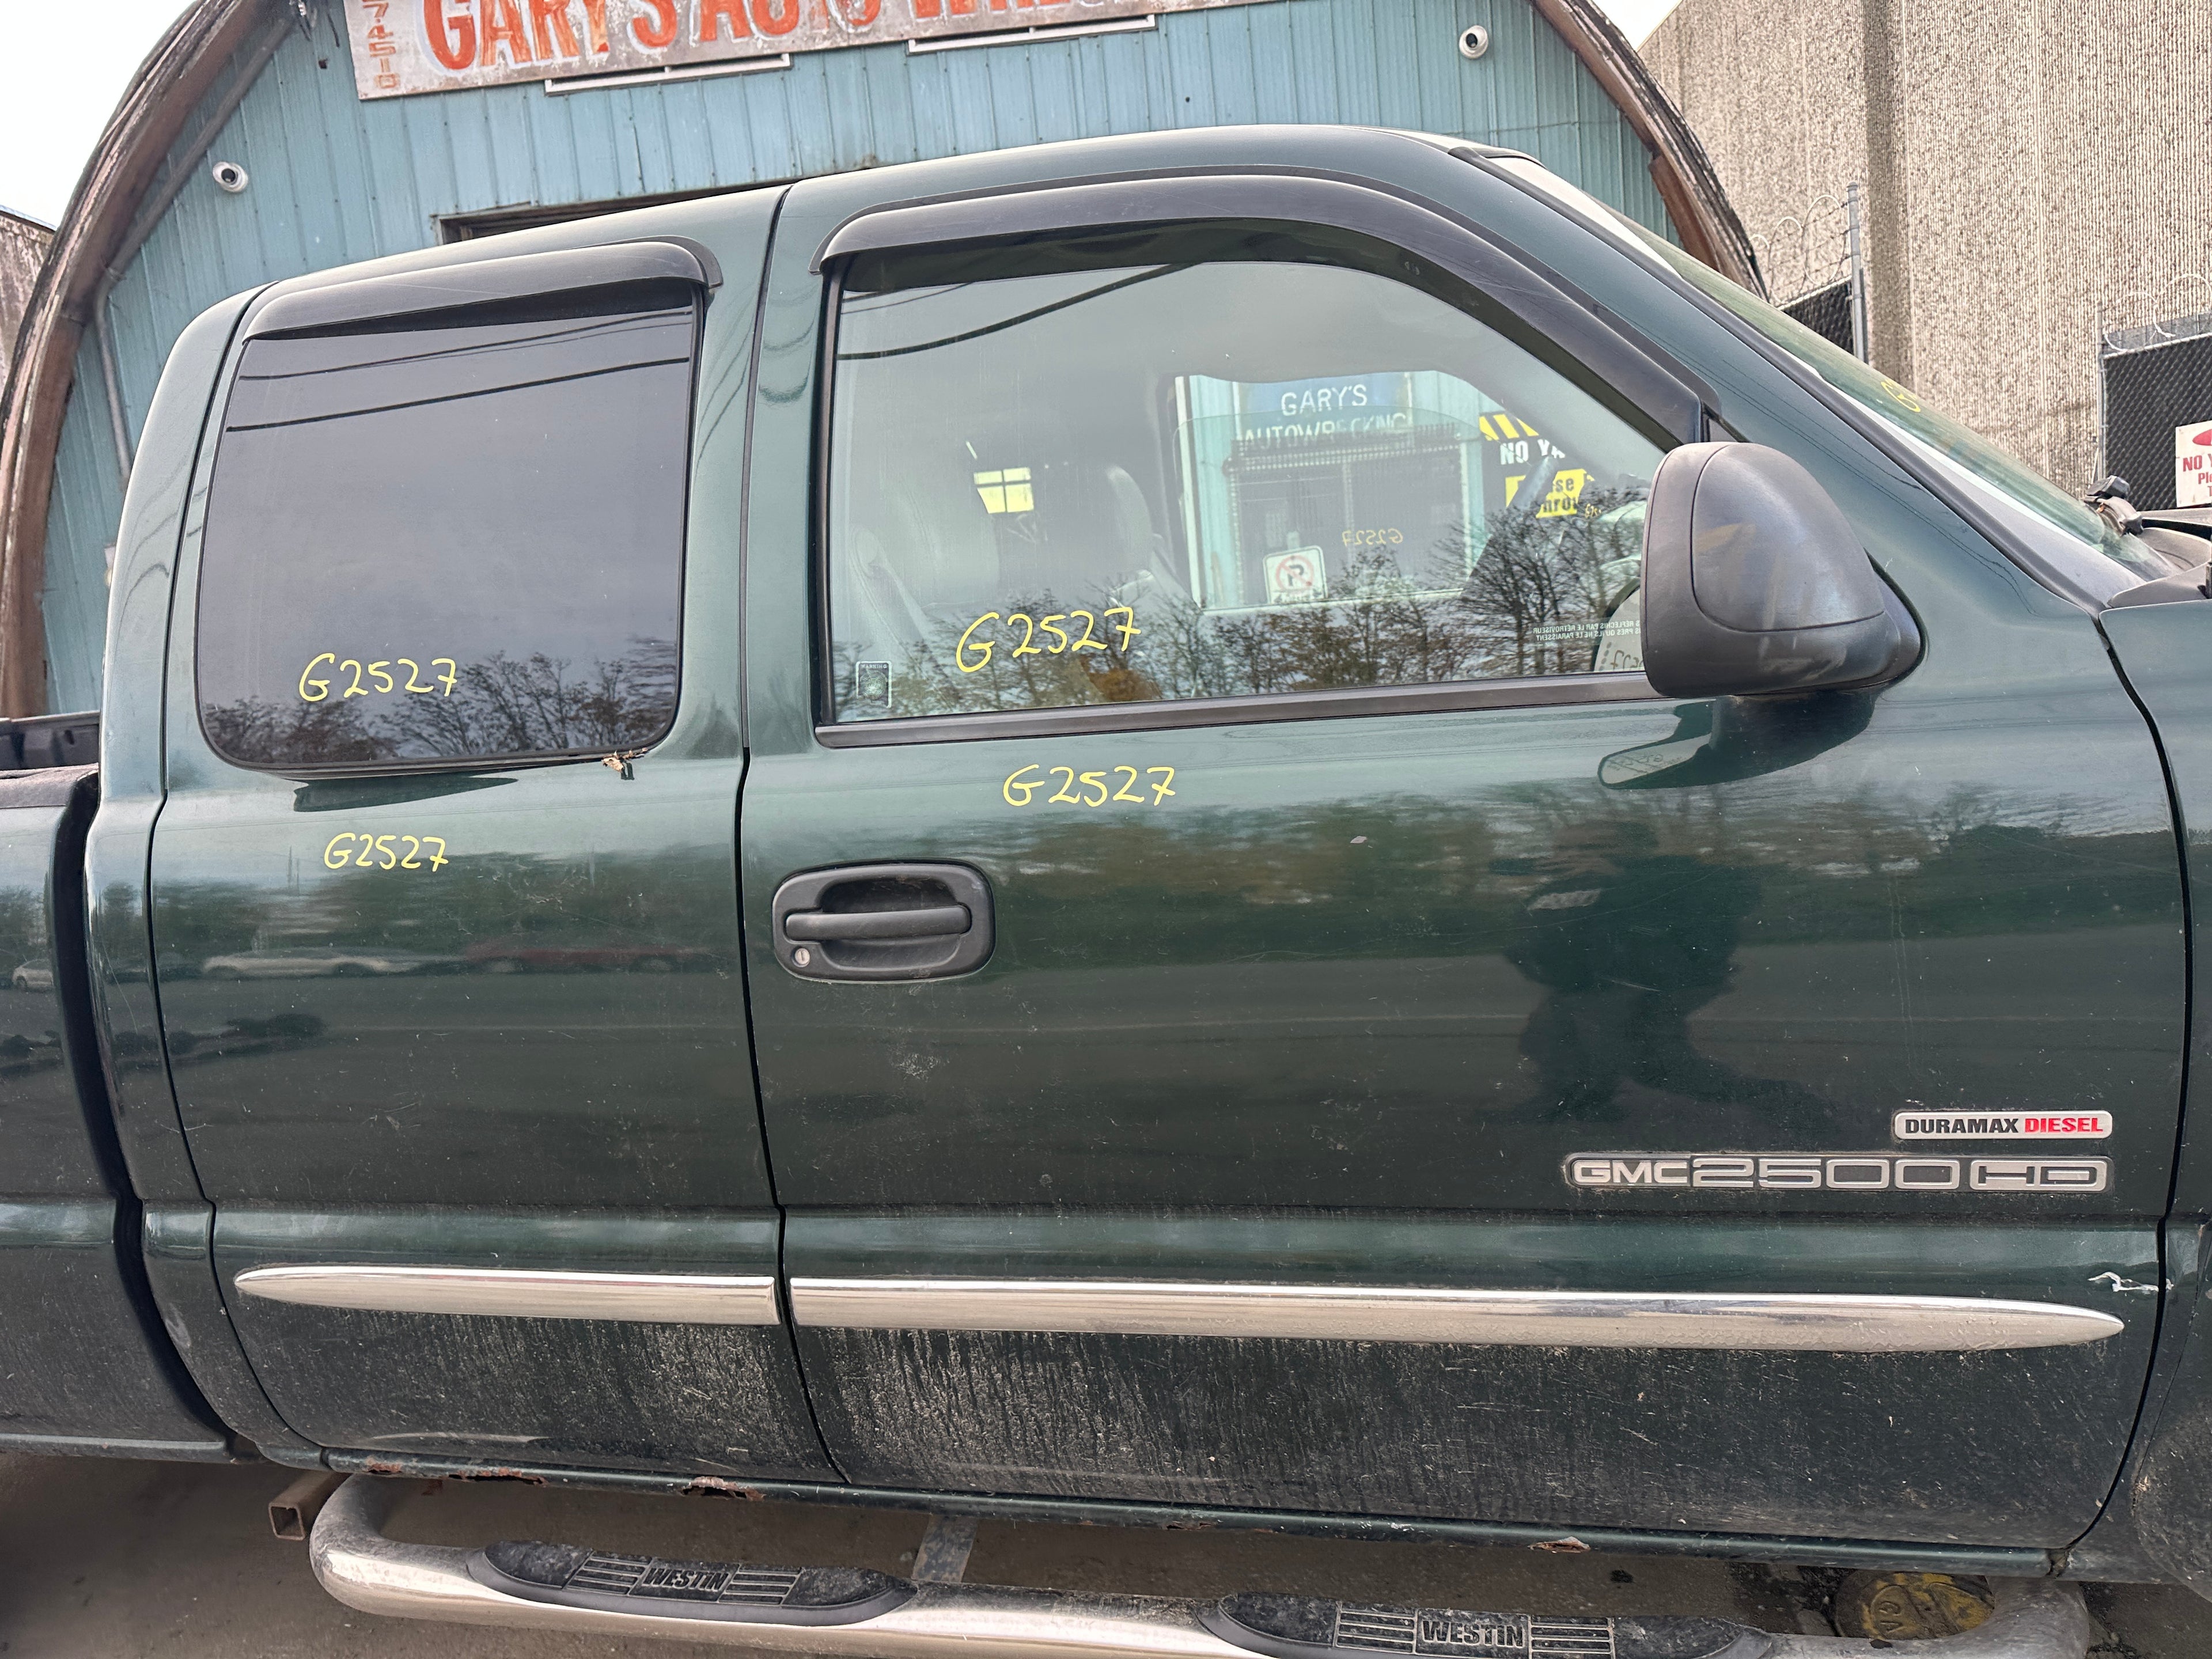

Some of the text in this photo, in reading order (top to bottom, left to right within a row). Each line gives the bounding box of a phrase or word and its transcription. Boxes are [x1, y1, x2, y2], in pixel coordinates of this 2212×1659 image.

[1281, 384, 1368, 416] GARY'S
[1499, 440, 1529, 465] NO
[2183, 454, 2203, 472] NO
[956, 607, 1142, 673] G2527
[299, 653, 457, 702] G2527
[1003, 764, 1176, 806] G2527
[324, 832, 449, 872] G2527
[1905, 1117, 2104, 1134] DURAMAX DIESEL
[1573, 1157, 2108, 1192] GMC 2500 HD
[642, 1567, 730, 1592] WESTIN
[1422, 1619, 1525, 1649] WESTIN
